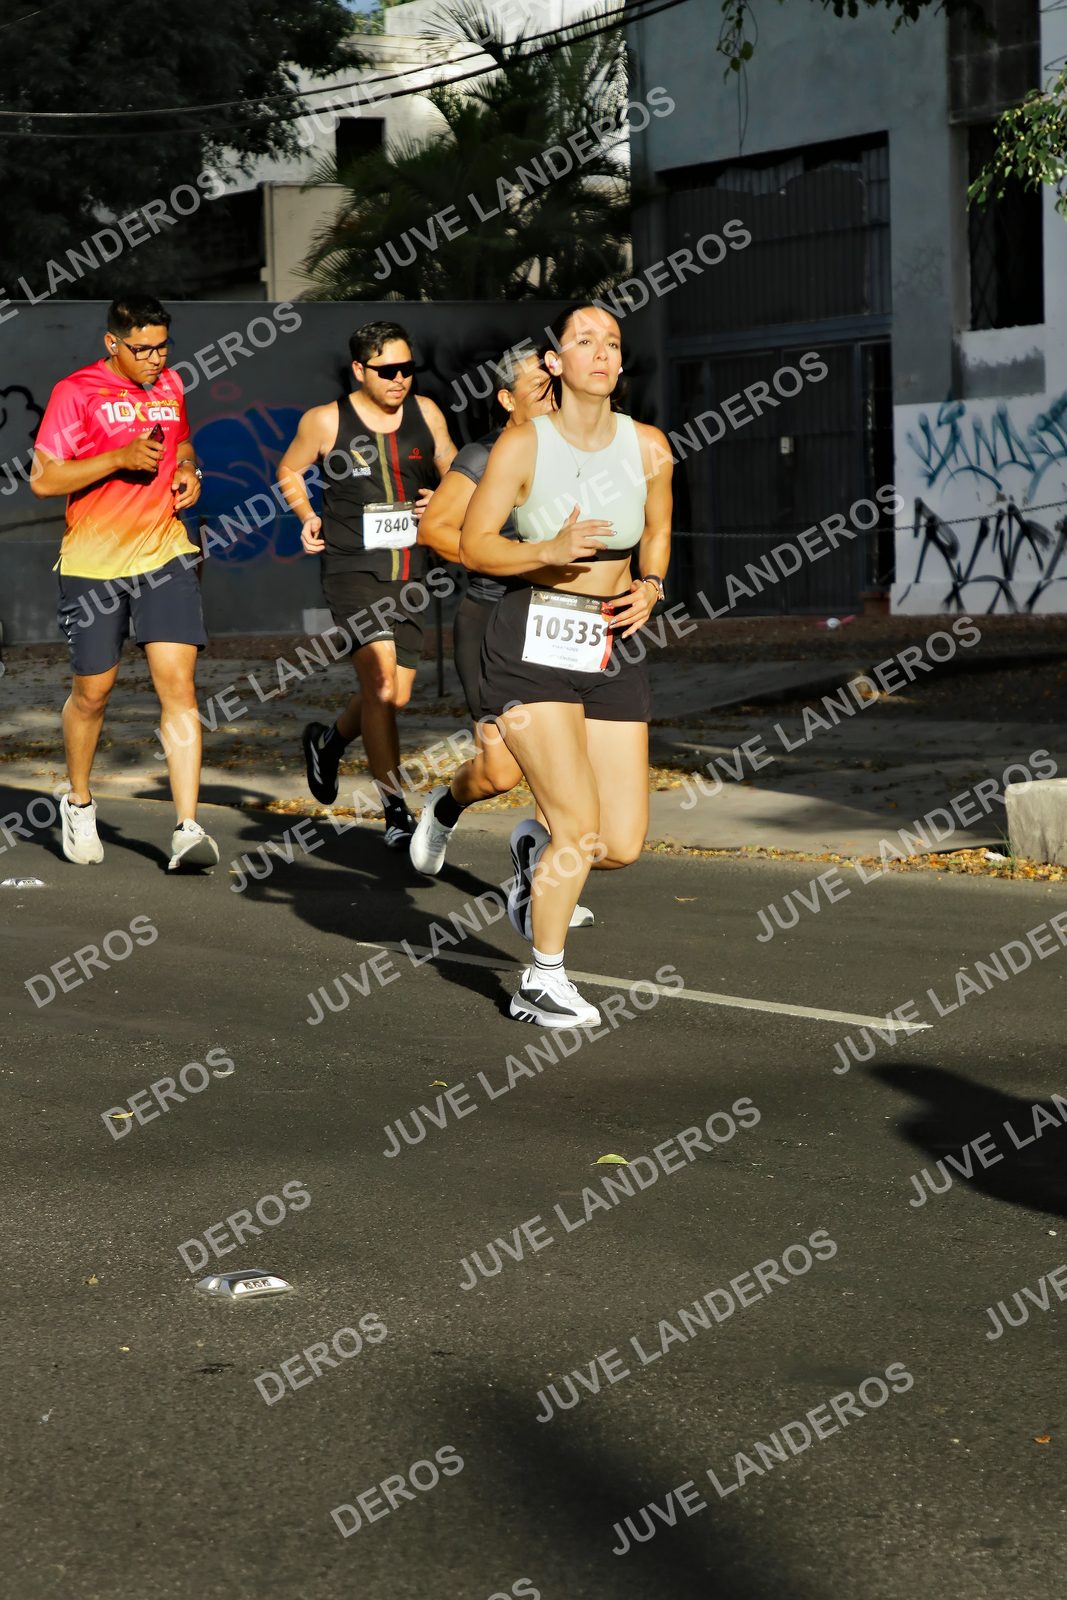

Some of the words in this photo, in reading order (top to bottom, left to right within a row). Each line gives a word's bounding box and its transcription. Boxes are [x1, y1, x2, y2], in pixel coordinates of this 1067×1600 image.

[148, 406, 180, 422] GDL
[375, 517, 409, 534] 7840
[533, 615, 602, 646] 10535
